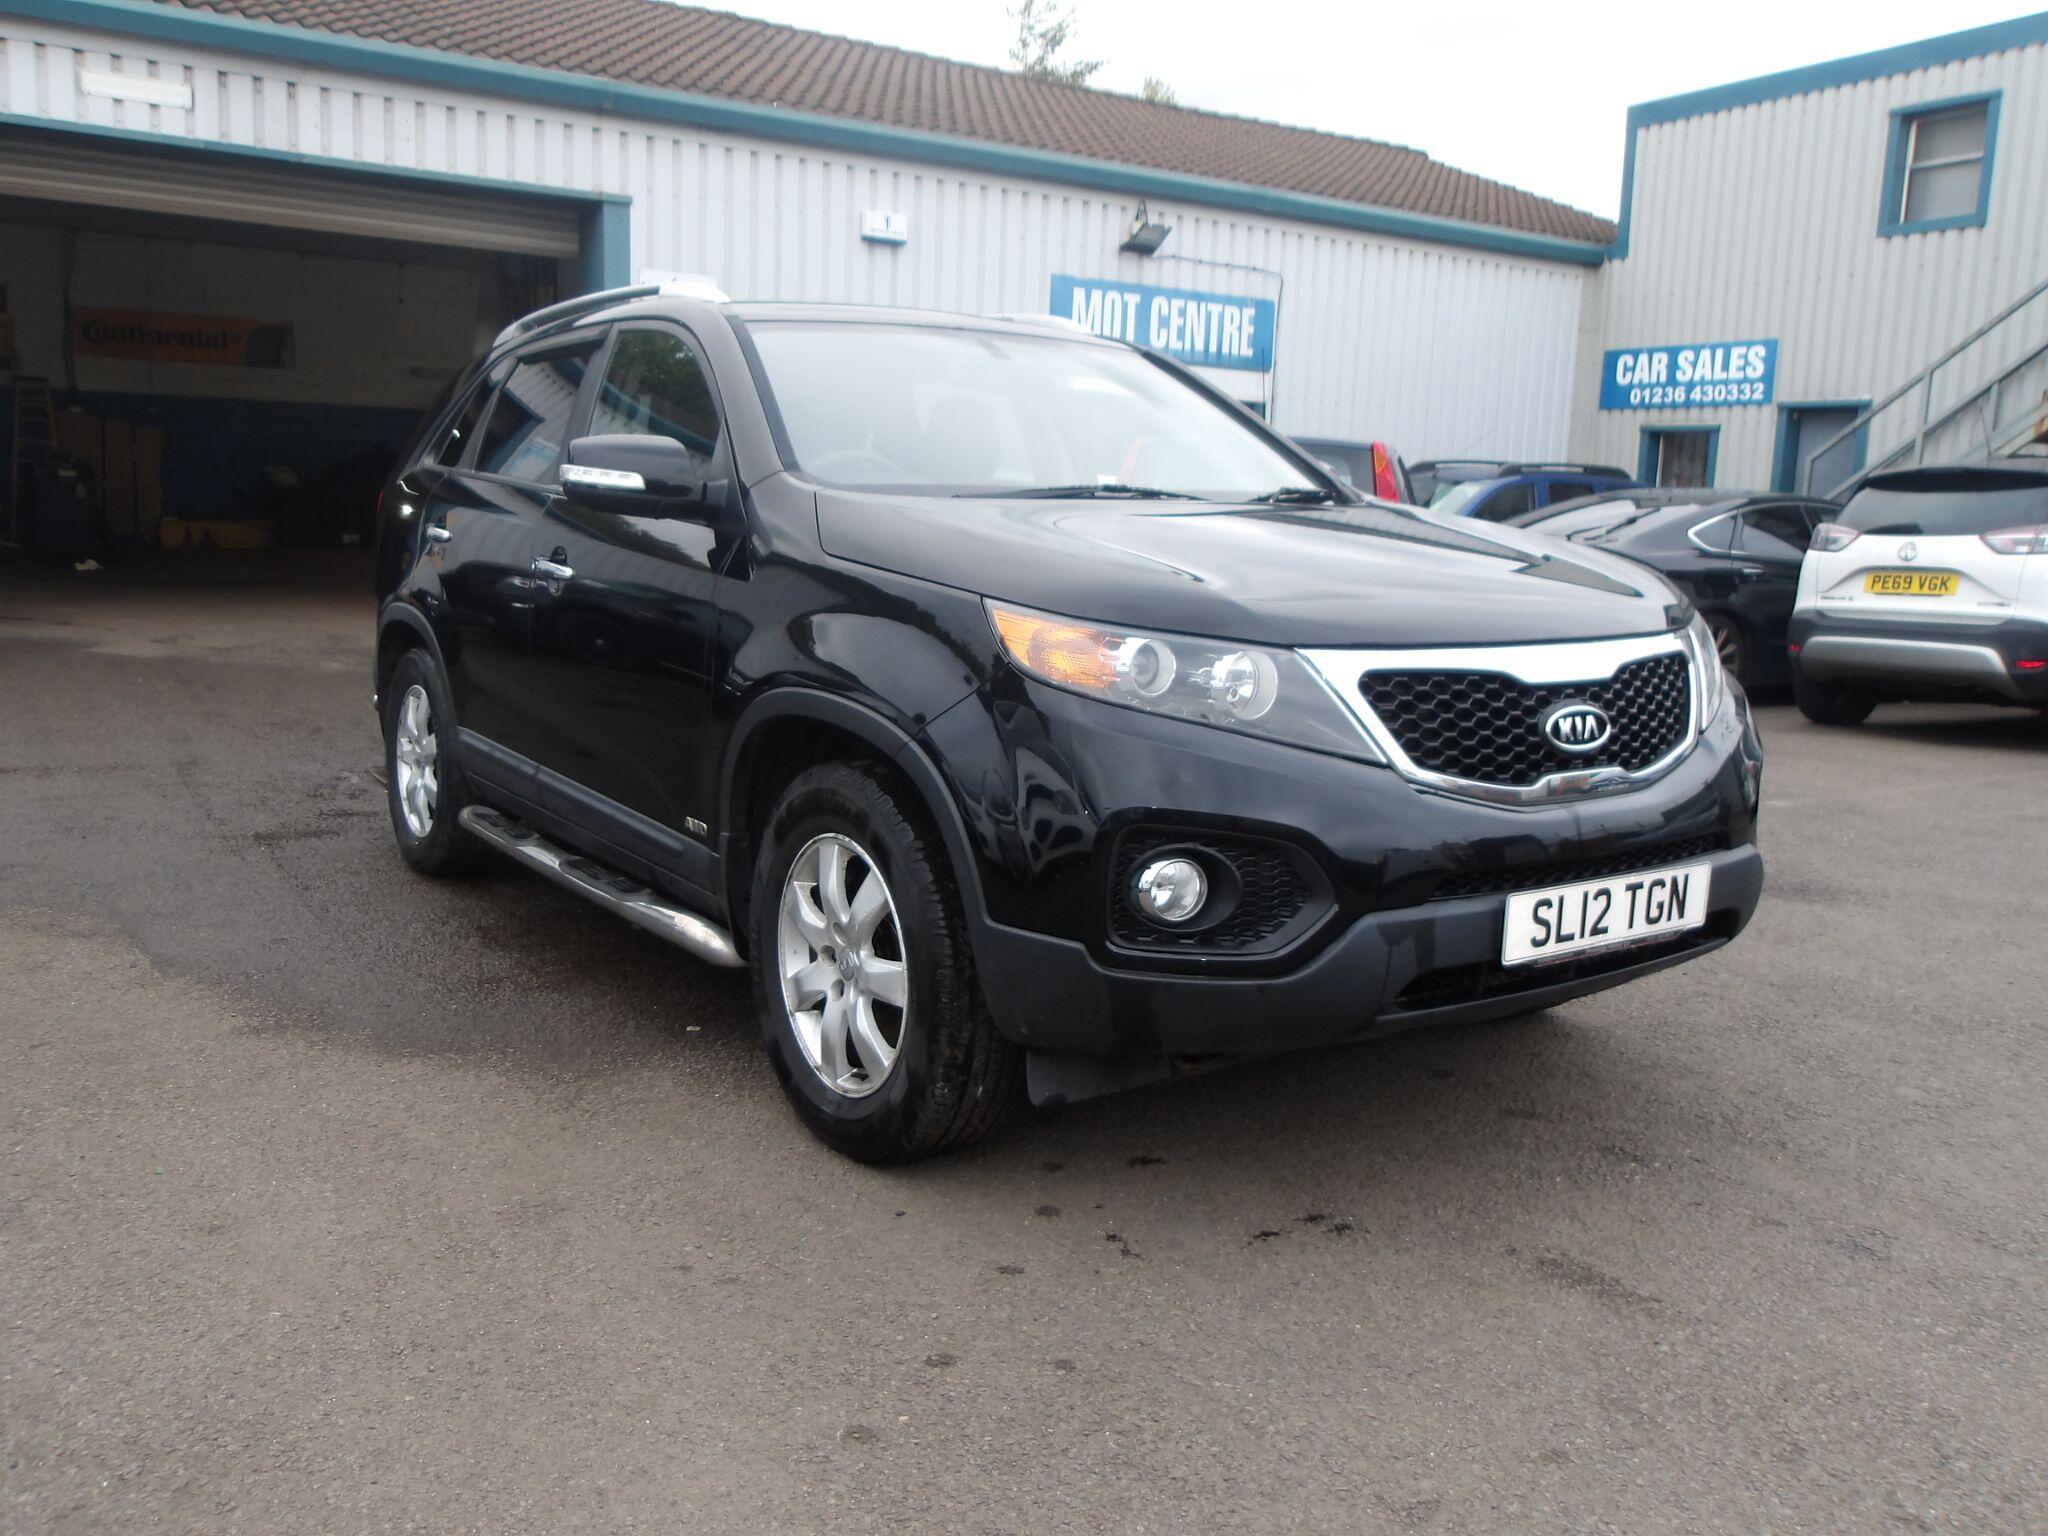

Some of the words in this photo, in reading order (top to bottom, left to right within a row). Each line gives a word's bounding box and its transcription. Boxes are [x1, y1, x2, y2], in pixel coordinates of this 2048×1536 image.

[1072, 286, 1141, 342] MOT
[1150, 296, 1255, 357] CENTRE
[1615, 352, 1668, 386] CAR
[1674, 344, 1766, 382] SALES
[1630, 385, 1686, 405] 01236
[1689, 382, 1764, 404] 430332
[1871, 574, 1913, 591] PE69
[1918, 575, 1951, 592] VGK
[1558, 714, 1599, 741] KIA
[1530, 887, 1612, 948] SL12
[1625, 873, 1689, 930] TGN
